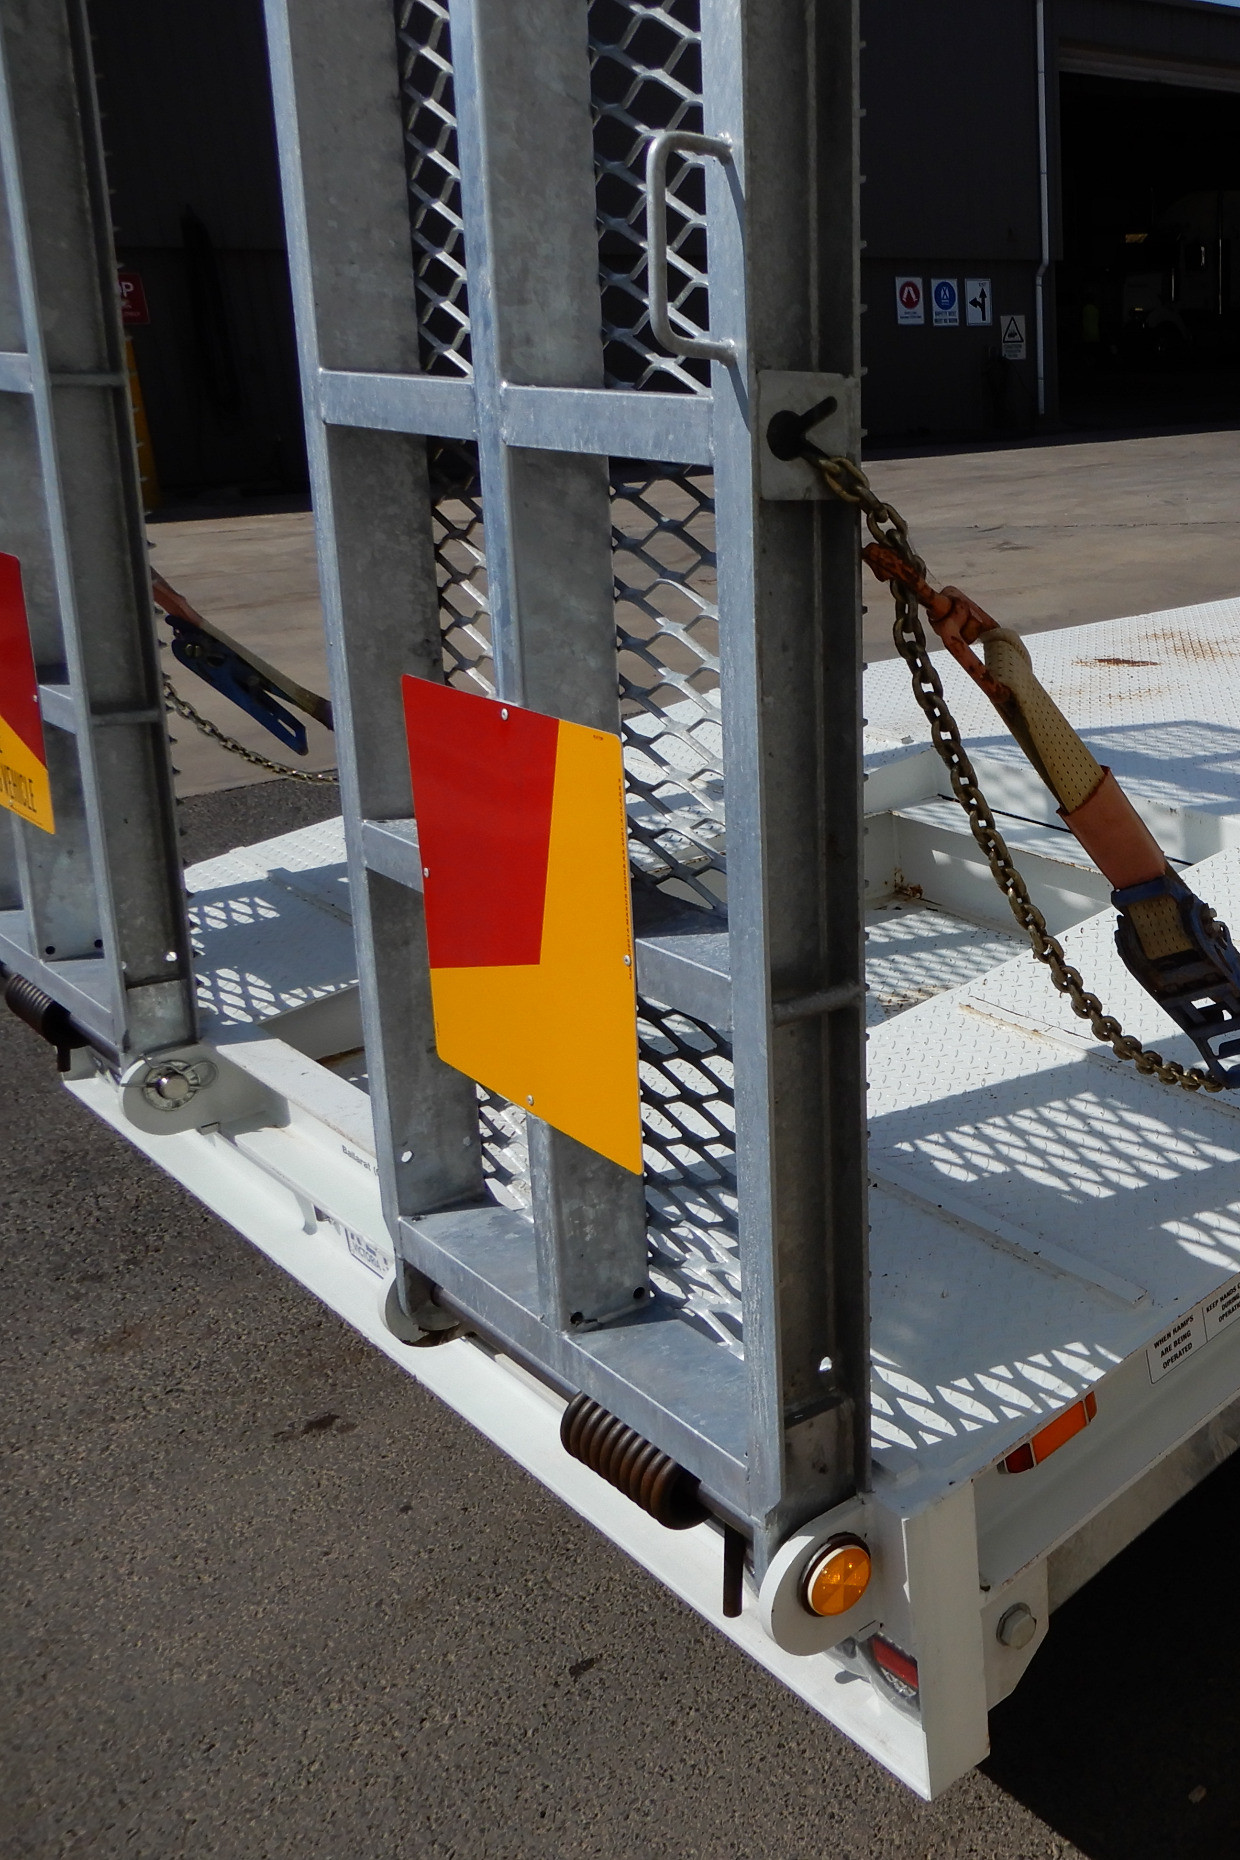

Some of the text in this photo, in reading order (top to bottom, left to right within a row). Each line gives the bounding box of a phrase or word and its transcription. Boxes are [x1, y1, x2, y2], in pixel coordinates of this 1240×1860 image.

[341, 1145, 371, 1172] Ballarat
[1206, 1300, 1219, 1313] KEEP
[1220, 1286, 1237, 1301] HANDS
[1221, 1293, 1240, 1311] DURING
[1153, 1314, 1194, 1349] WHEN RAMPS
[1160, 1330, 1192, 1358] ARE BEING
[1162, 1342, 1193, 1369] OPERATED
